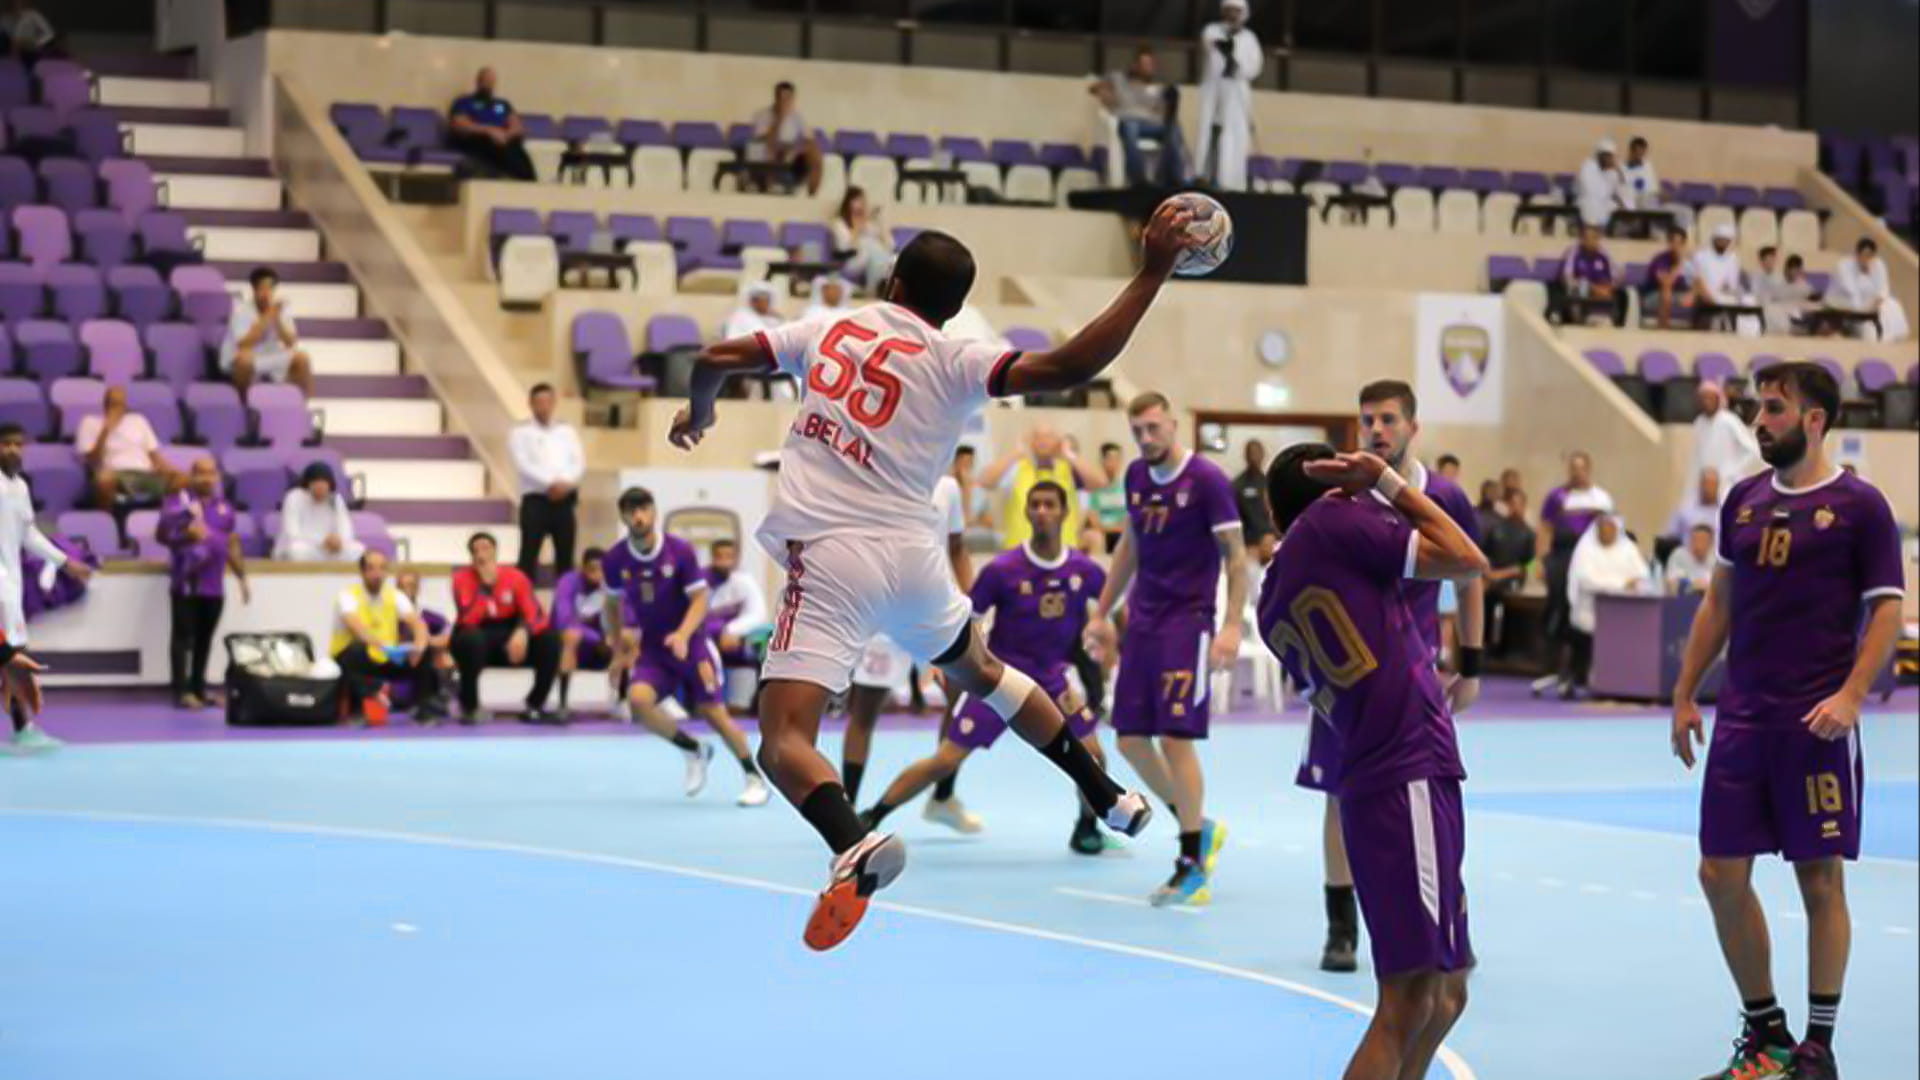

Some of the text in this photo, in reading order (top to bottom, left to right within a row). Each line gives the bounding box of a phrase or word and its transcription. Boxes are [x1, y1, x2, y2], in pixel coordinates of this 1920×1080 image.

[808, 318, 927, 428] 55
[1143, 505, 1168, 532] 77
[1757, 527, 1792, 567] 18
[1268, 585, 1379, 715] 20
[1163, 669, 1192, 699] 77
[1806, 772, 1843, 814] 18
